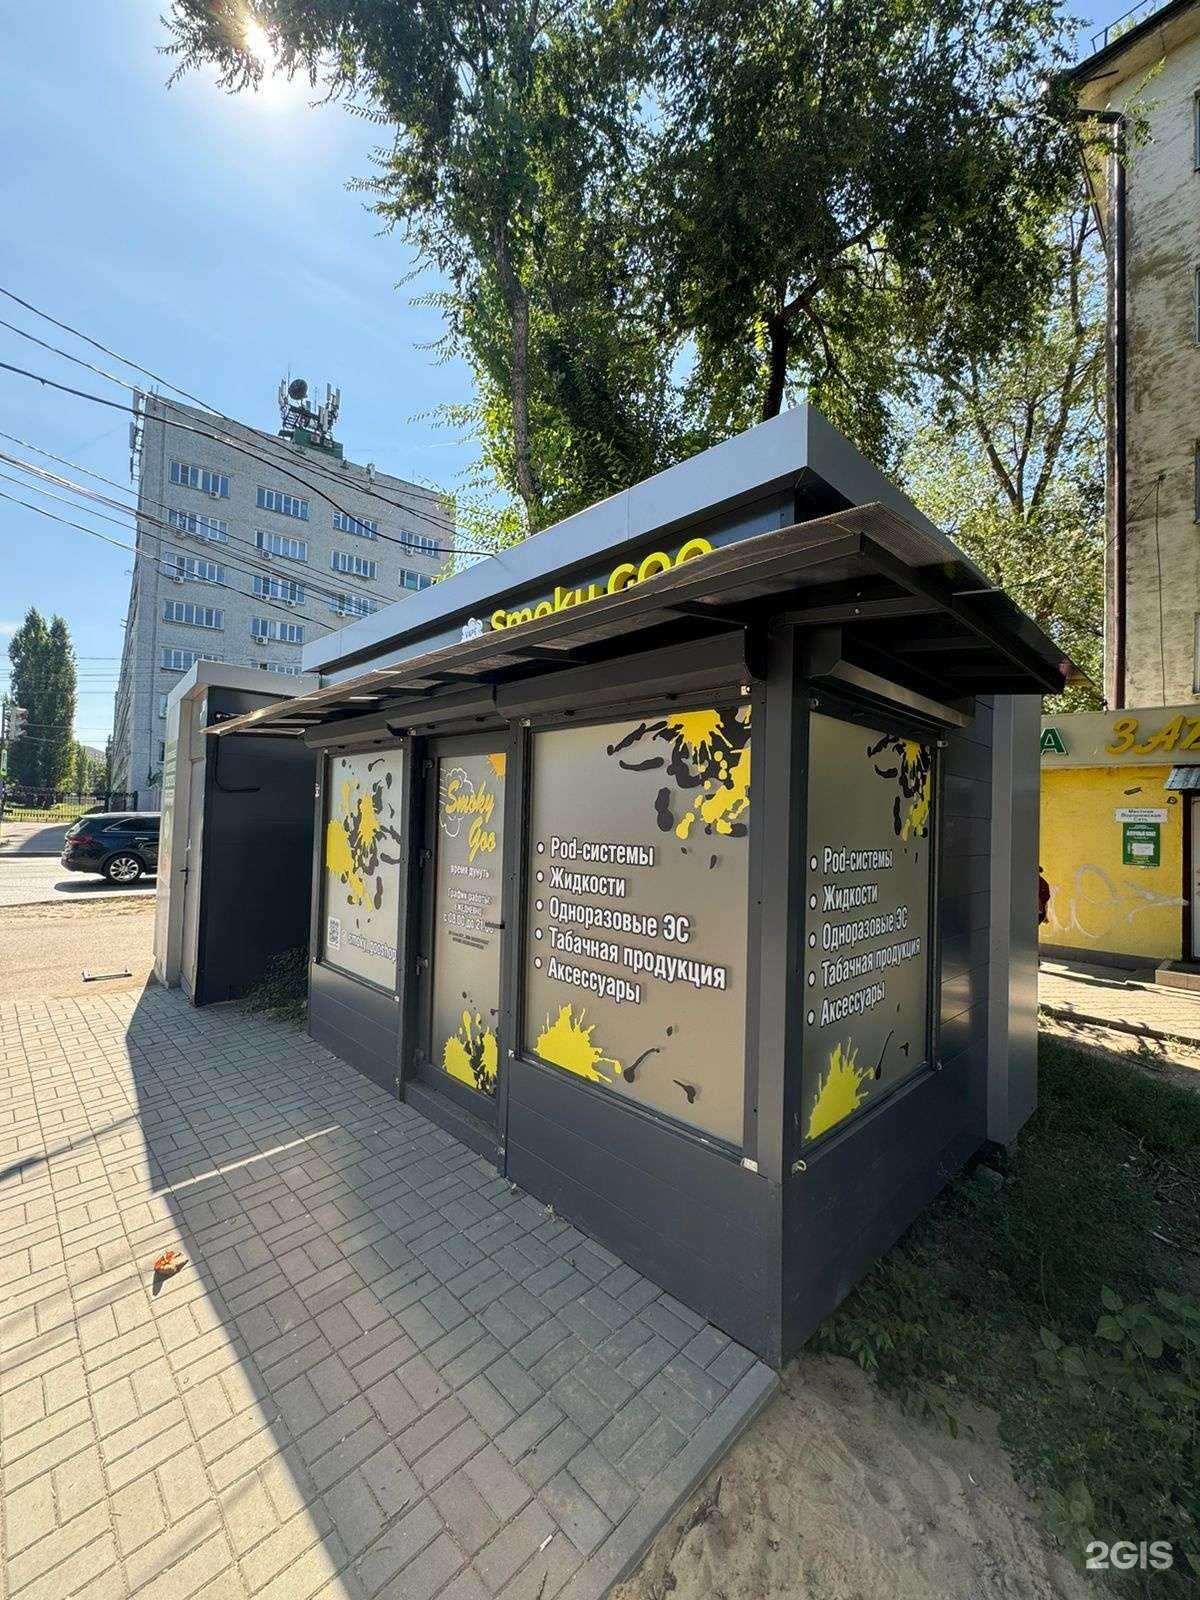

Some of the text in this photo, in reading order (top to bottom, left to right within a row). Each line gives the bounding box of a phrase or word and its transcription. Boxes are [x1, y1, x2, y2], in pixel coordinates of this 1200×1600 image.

[445, 780, 495, 823] Smoky
[550, 836, 655, 867] Pod-системы
[823, 845, 893, 873] Pod-системы
[549, 866, 627, 898] Жидкости
[822, 884, 878, 912] Жидкости
[549, 896, 690, 944] Одноразовые ЭС
[822, 906, 908, 952] Одноразовые ЭС
[548, 957, 641, 1004] Аксессуары
[549, 926, 727, 990] Табачная продукция
[821, 937, 921, 989] Табачная продукция
[820, 980, 886, 1028] Аксессуары
